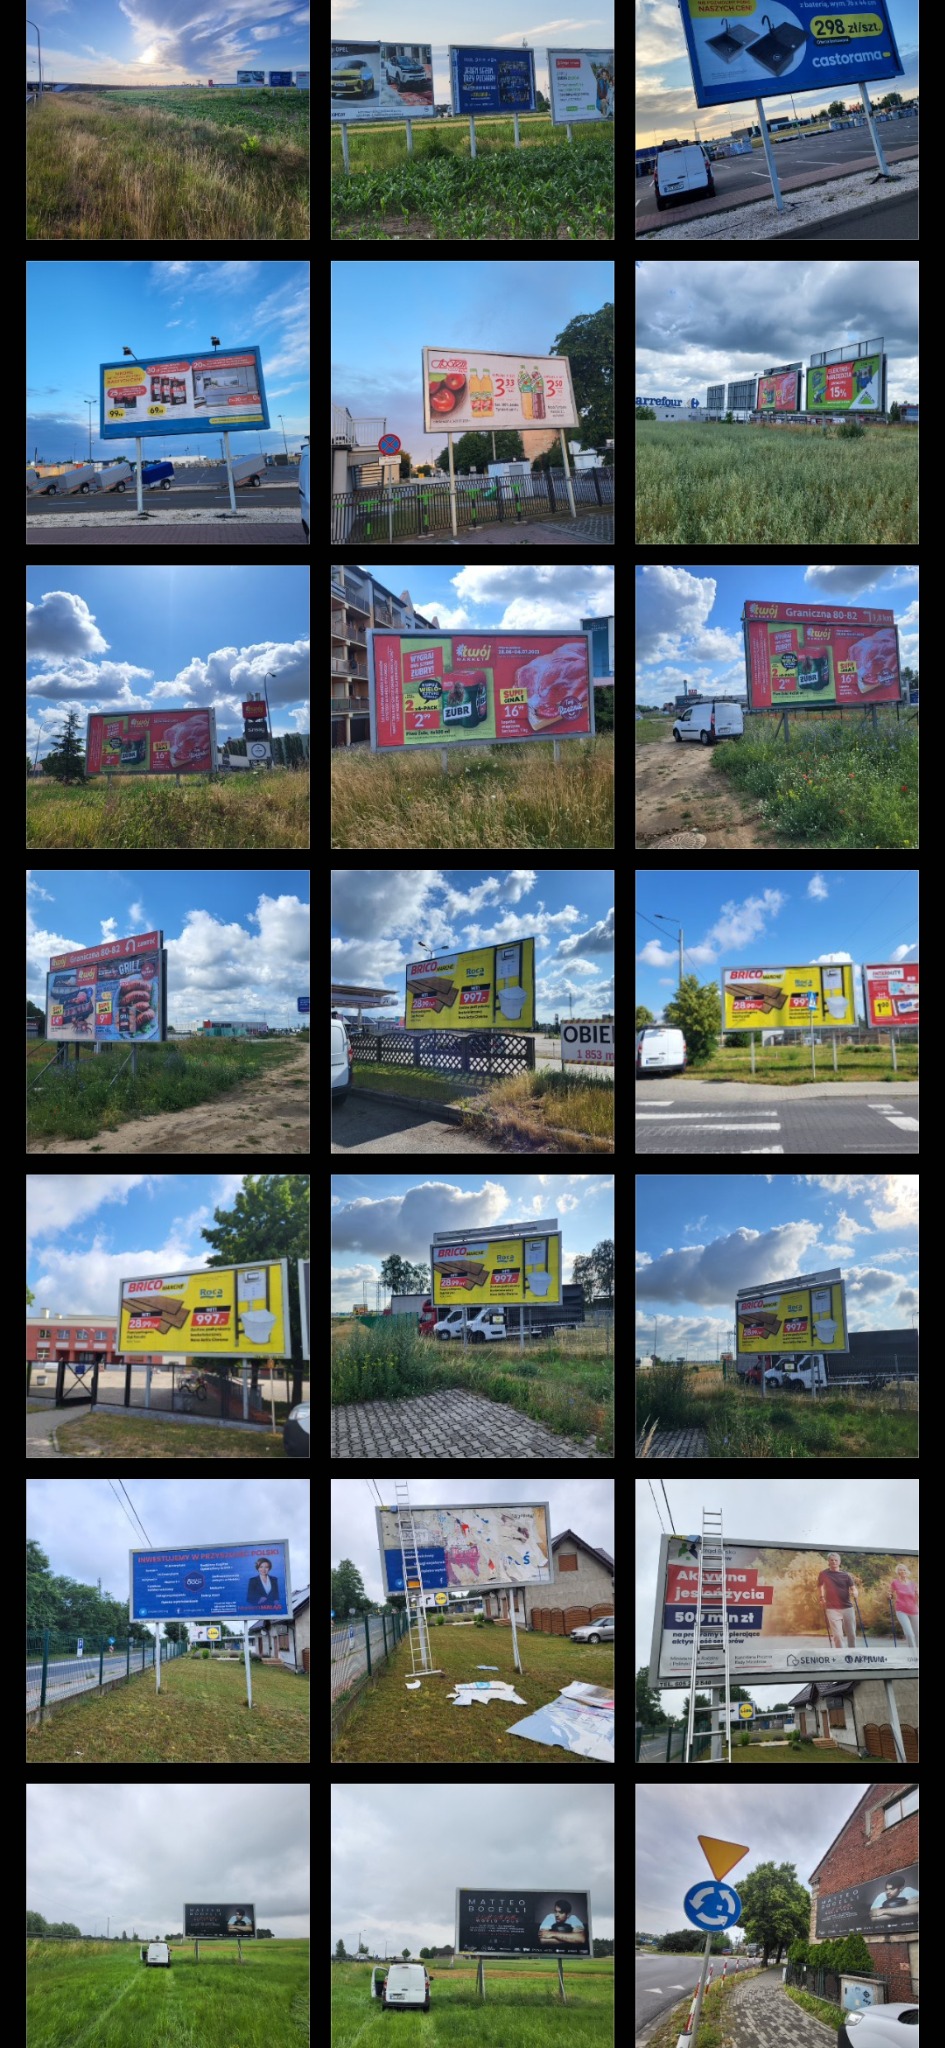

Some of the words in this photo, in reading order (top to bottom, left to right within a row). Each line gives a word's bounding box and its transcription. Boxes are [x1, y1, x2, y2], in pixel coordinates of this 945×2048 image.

[815, 18, 845, 36] 298
[848, 22, 881, 34] zł/szt.
[812, 50, 882, 68] castorama
[830, 386, 847, 398] 15%
[636, 396, 682, 406] arrefour
[786, 607, 831, 619] Graniczna
[833, 611, 857, 620] 80-82
[463, 645, 491, 661] twój
[404, 700, 414, 711] 2
[505, 706, 519, 717] 16
[415, 714, 424, 727] 2
[118, 960, 141, 975] GRILL
[411, 962, 438, 975] BRICO
[466, 967, 484, 975] Roca
[730, 970, 763, 980] BRICO
[564, 1026, 615, 1043] OBIE
[578, 1050, 582, 1058] 1
[585, 1050, 602, 1060] 853
[438, 1247, 467, 1258] BRICO
[128, 1280, 163, 1293] BRICO
[741, 1300, 764, 1310] BRICO
[138, 1555, 190, 1563] INWESTUJEMY
[708, 1613, 738, 1623] mn
[741, 1613, 754, 1623] zł
